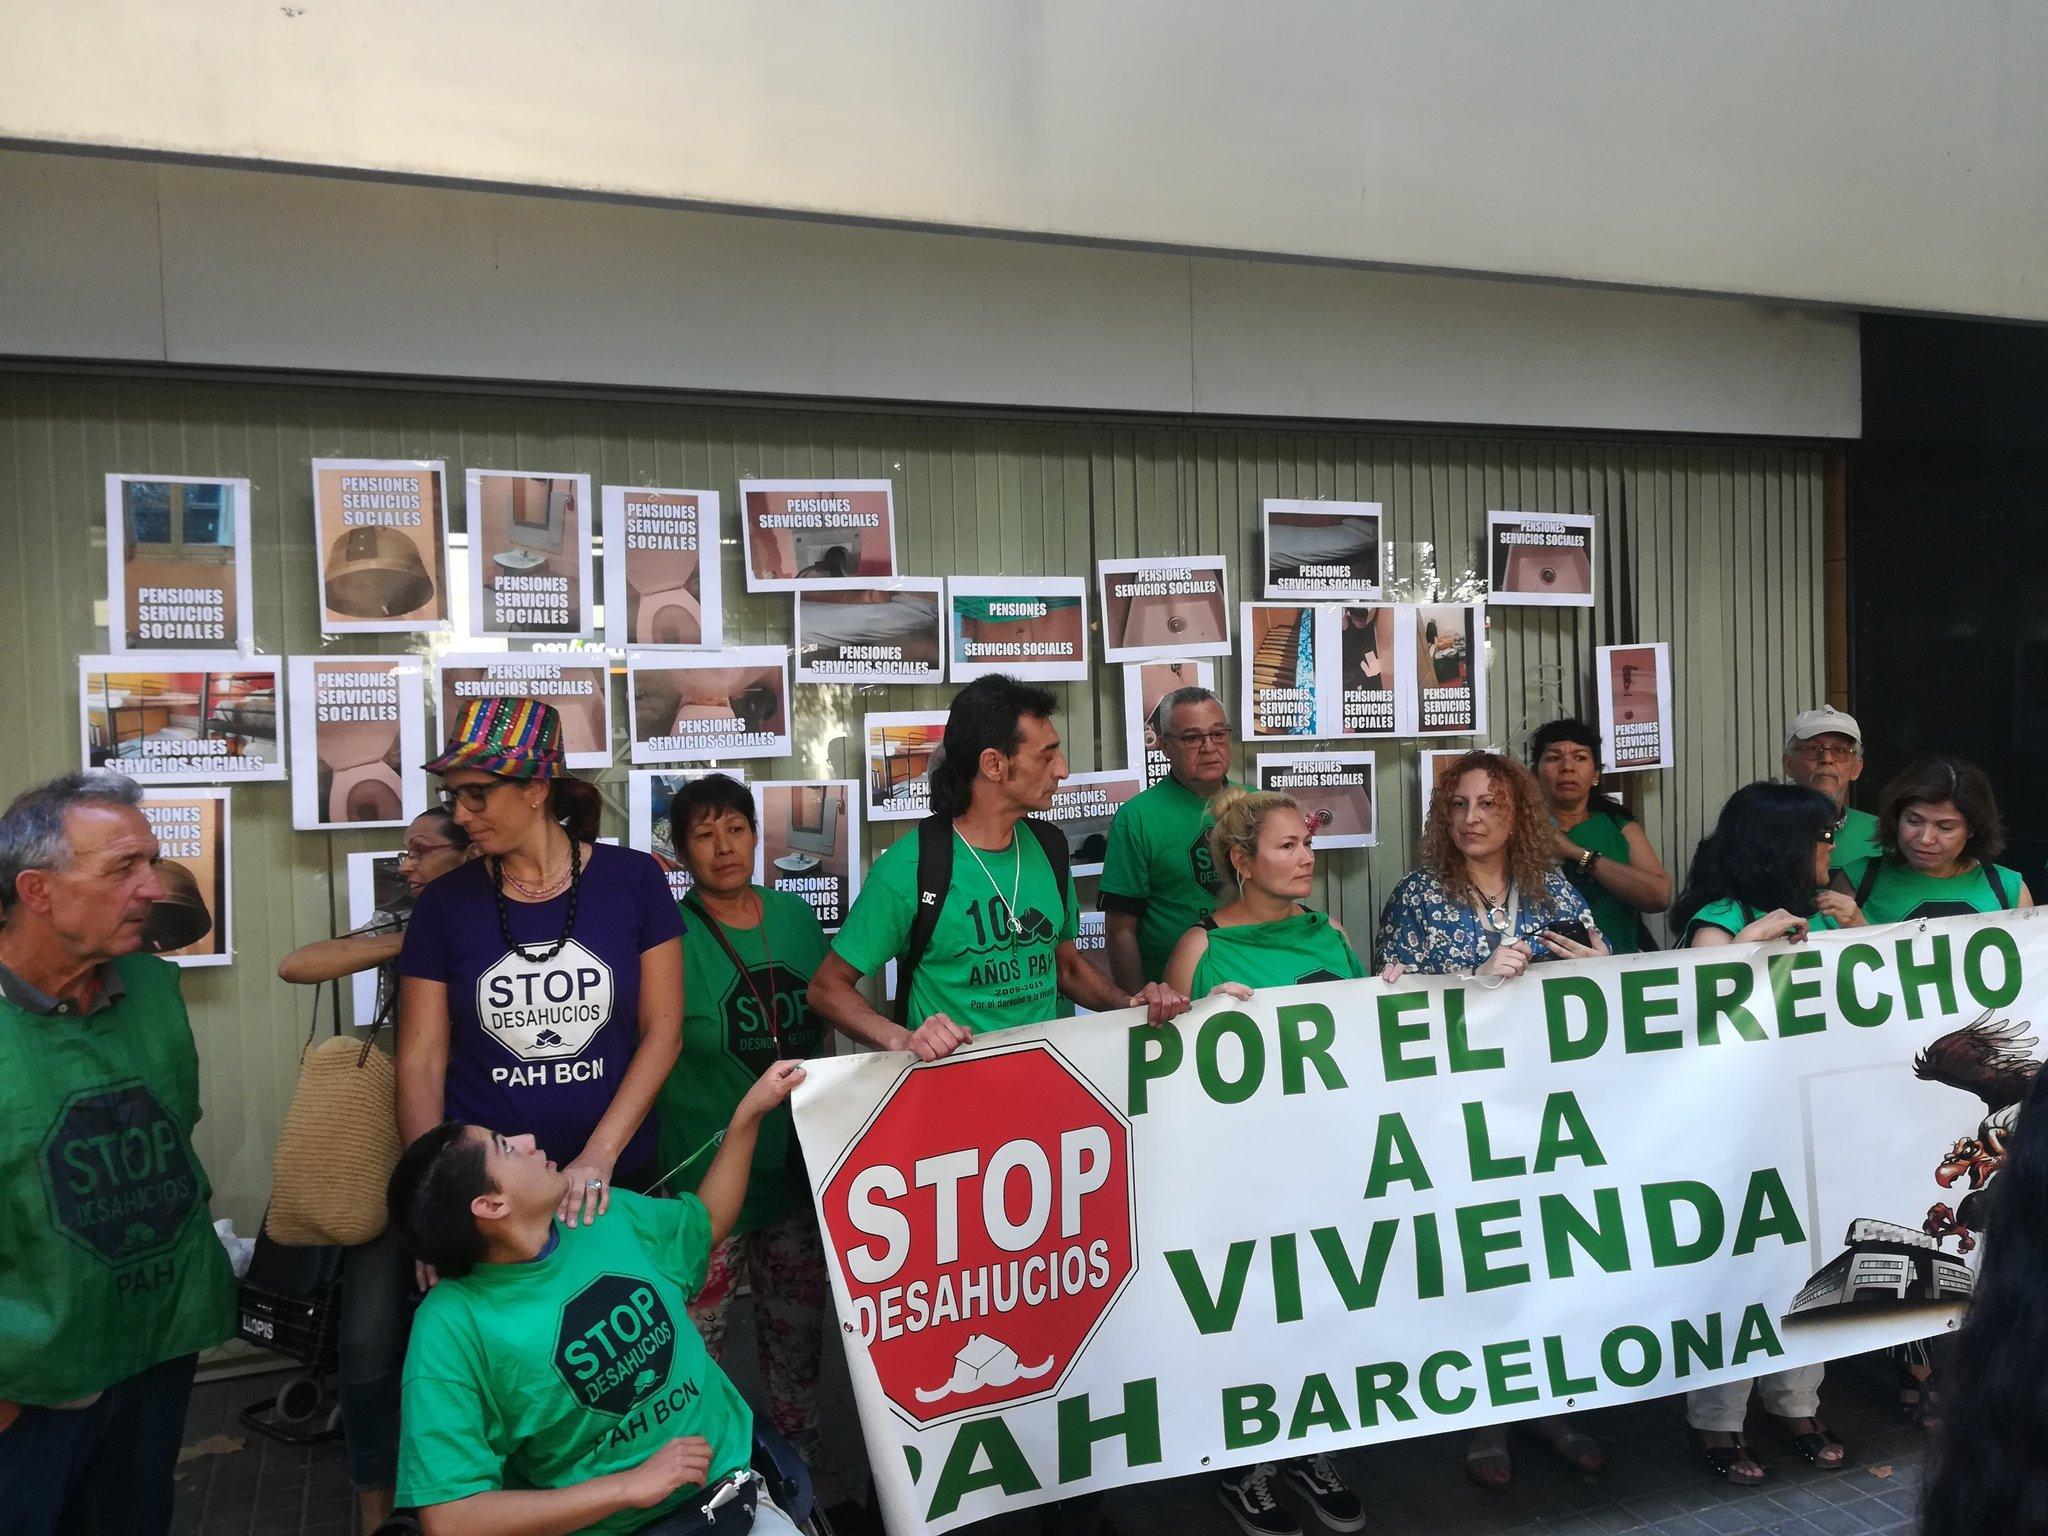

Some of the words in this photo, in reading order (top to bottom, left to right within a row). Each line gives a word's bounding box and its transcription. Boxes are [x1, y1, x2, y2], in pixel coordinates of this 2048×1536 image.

[342, 478, 419, 492] PENSIONES
[343, 494, 420, 510] SERVICIOS
[787, 499, 850, 512] PENSIONES
[344, 511, 422, 526] SOCIALES
[627, 503, 696, 519] PENSIONES
[627, 519, 696, 535] SERVICIOS
[760, 514, 822, 528] SERVICIOS
[824, 514, 879, 528] SOCIALES
[1521, 521, 1566, 533] PENSIONES
[628, 535, 697, 550] SOCIALES
[1500, 532, 1544, 545] SERVICIOS
[1546, 534, 1584, 546] SOCIALES
[1138, 568, 1192, 582] PENSIONES
[1300, 566, 1350, 578] PENSIONES
[495, 576, 568, 592] PENSIONES
[1115, 584, 1168, 598] SERVICIOS
[1169, 581, 1216, 595] SOCIALES
[1278, 578, 1326, 590] SERVICIOS
[1326, 578, 1372, 591] SOCIALES
[139, 588, 223, 604] PENSIONES
[495, 592, 568, 608] SERVICIOS
[139, 606, 224, 622] SERVICIOS
[495, 609, 568, 624] SOCIALES
[989, 602, 1046, 616] PENSIONES
[139, 623, 224, 639] SOCIALES
[840, 646, 901, 660] PENSIONES
[964, 642, 1020, 656] SERVICIOS
[1023, 642, 1073, 656] SOCIALES
[488, 664, 560, 680] PENSIONES
[811, 660, 872, 675] SERVICIOS
[874, 661, 928, 675] SOCIALES
[318, 672, 396, 687] PENSIONES
[318, 688, 396, 704] SERVICIOS
[454, 680, 528, 696] SERVICIOS
[530, 680, 593, 696] SOCIALES
[1260, 688, 1310, 700] PENSIONES
[1344, 690, 1393, 702] PENSIONES
[1424, 688, 1470, 700] PENSIONES
[318, 705, 397, 722] SOCIALES
[1260, 702, 1310, 714] SERVICIOS
[1344, 704, 1393, 715] SERVICIOS
[1424, 700, 1470, 712] SERVICIOS
[679, 718, 746, 734] PENSIONES
[1260, 716, 1310, 728] SOCIALES
[1344, 716, 1394, 728] SOCIALES
[1424, 714, 1470, 726] SOCIALES
[1615, 722, 1658, 734] PENSIONES
[142, 740, 227, 756] PENSIONES
[648, 734, 717, 751] SERVICIOS
[718, 732, 775, 748] SOCIALES
[1616, 734, 1658, 748] SERVICIOS
[1616, 747, 1659, 760] SOCIALES
[104, 758, 192, 774] SERVICIOS
[193, 756, 264, 772] SOCIALES
[1292, 761, 1342, 773] PENSIONES
[1270, 774, 1318, 788] SERVICIOS
[1320, 774, 1364, 786] SOCIALES
[1052, 790, 1106, 806] PENSIONES
[775, 877, 838, 892] PENSIONES
[966, 895, 1009, 946] 10
[969, 959, 1020, 986] AÑOS
[489, 968, 601, 1008] STOP
[971, 1000, 984, 1008] Por
[492, 1005, 600, 1030] DESAHUCIOS
[1128, 1003, 1348, 1117] POR
[1376, 988, 1504, 1082] EL
[1542, 926, 2023, 1064] DERECHO
[492, 1064, 546, 1087] PAH
[555, 1058, 604, 1084] BCN
[1363, 1112, 1433, 1199] A
[1462, 1090, 1608, 1182] LA
[63, 1120, 176, 1194] STOP
[845, 1125, 1111, 1284] STOP
[1163, 1167, 1806, 1335] VIVIENDA
[852, 1239, 1110, 1349] DESAHUCIOS
[564, 1286, 655, 1380] STOP
[584, 1321, 672, 1403] DESAHUCIOS
[1222, 1303, 1785, 1451] BARCELONA
[653, 1377, 700, 1424] BCN
